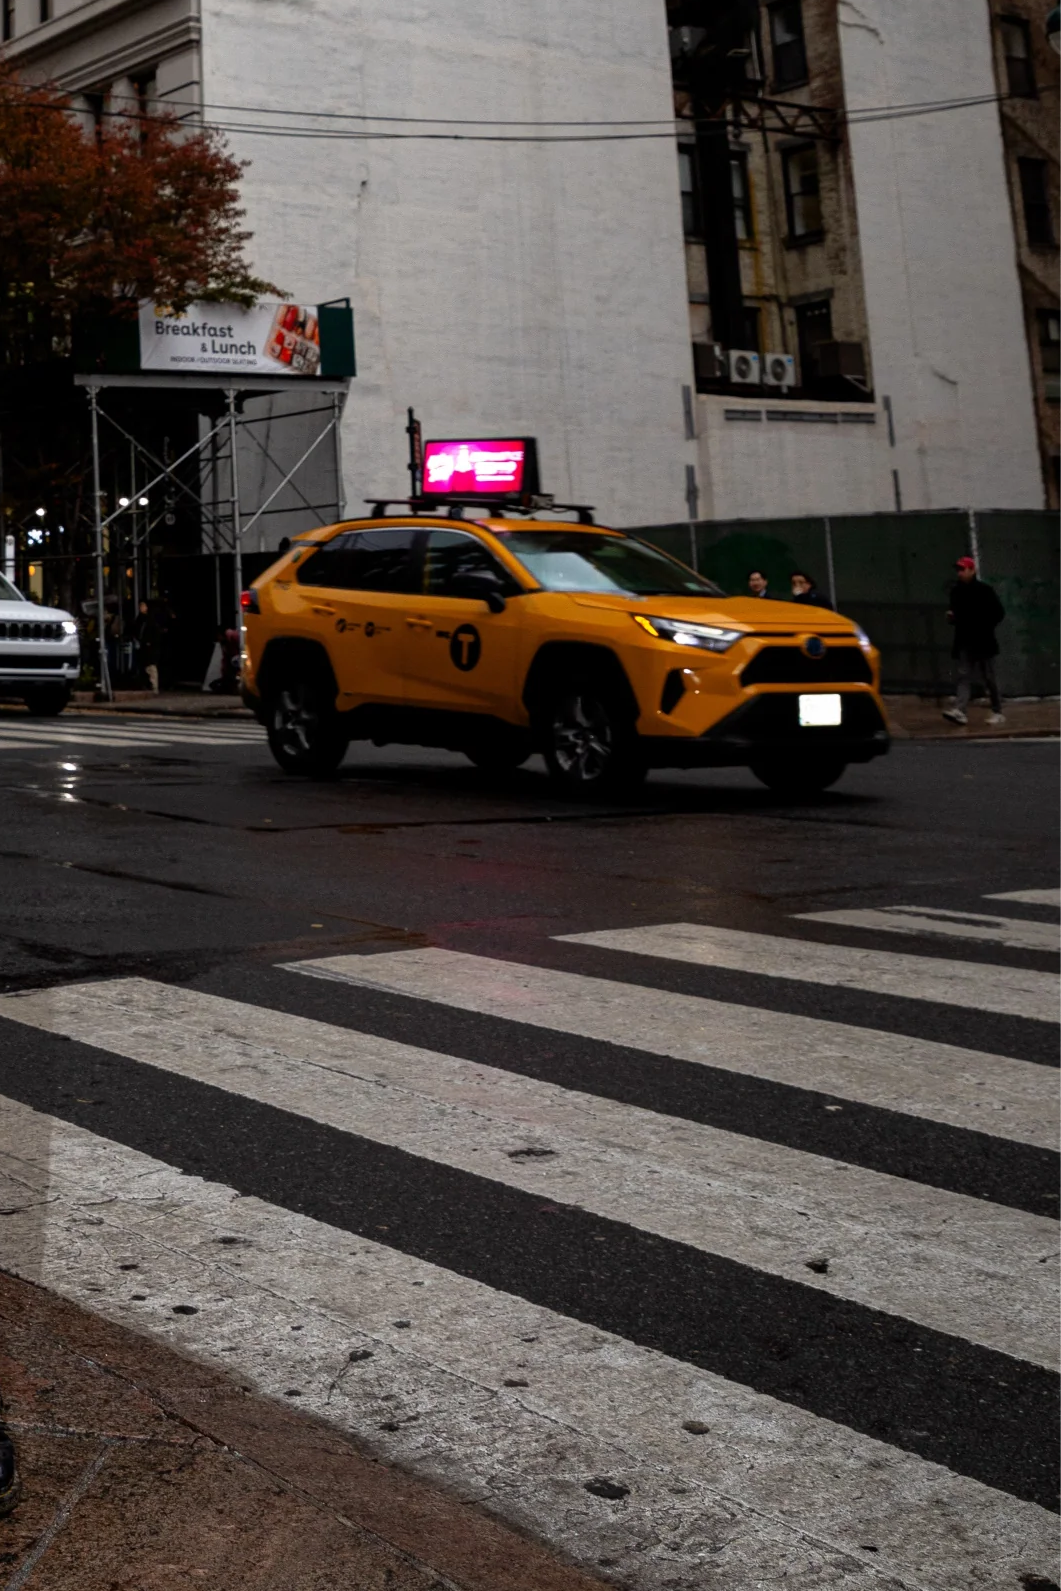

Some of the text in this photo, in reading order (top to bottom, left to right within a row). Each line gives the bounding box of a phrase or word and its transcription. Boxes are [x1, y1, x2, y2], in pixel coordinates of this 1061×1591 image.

[155, 321, 233, 338] Breakfast
[201, 340, 256, 355] & Lunch
